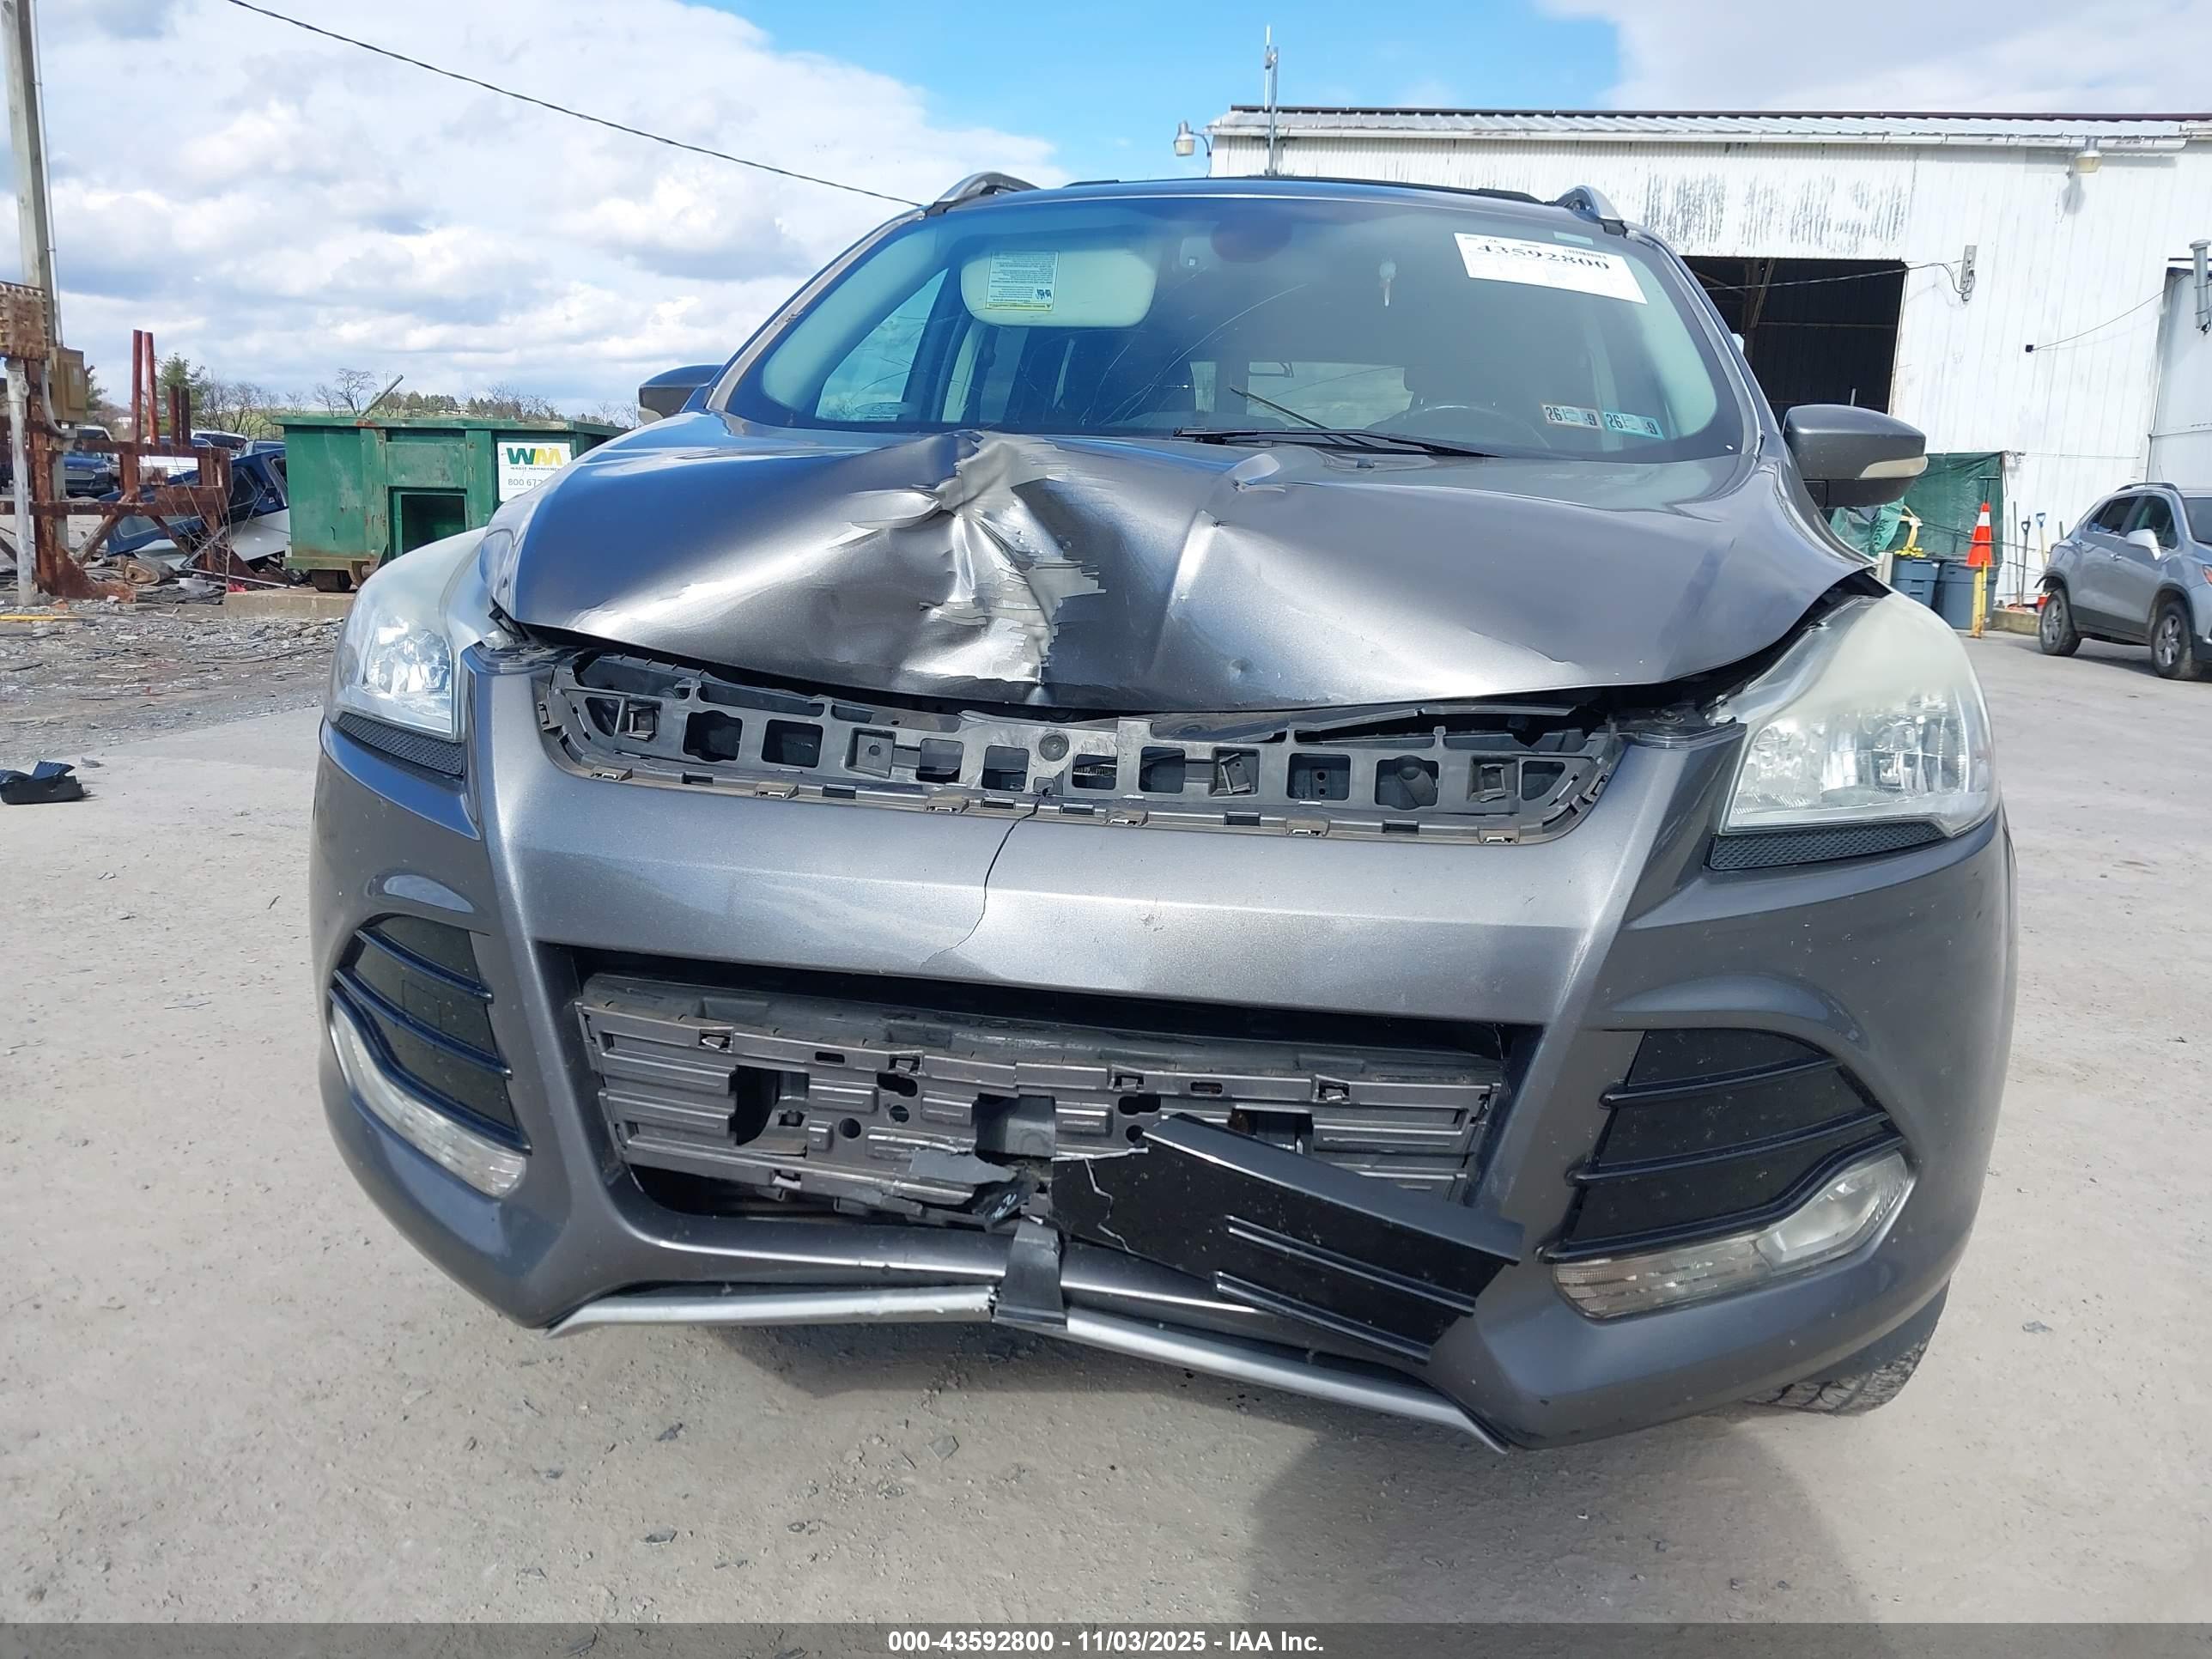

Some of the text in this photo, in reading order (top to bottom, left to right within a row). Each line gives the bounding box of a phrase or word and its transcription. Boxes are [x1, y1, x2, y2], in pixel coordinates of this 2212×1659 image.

[1477, 244, 1610, 270] 43592800
[1546, 406, 1563, 422] 26
[1606, 413, 1623, 429] 26
[506, 447, 562, 465] WM
[507, 477, 525, 486] 800
